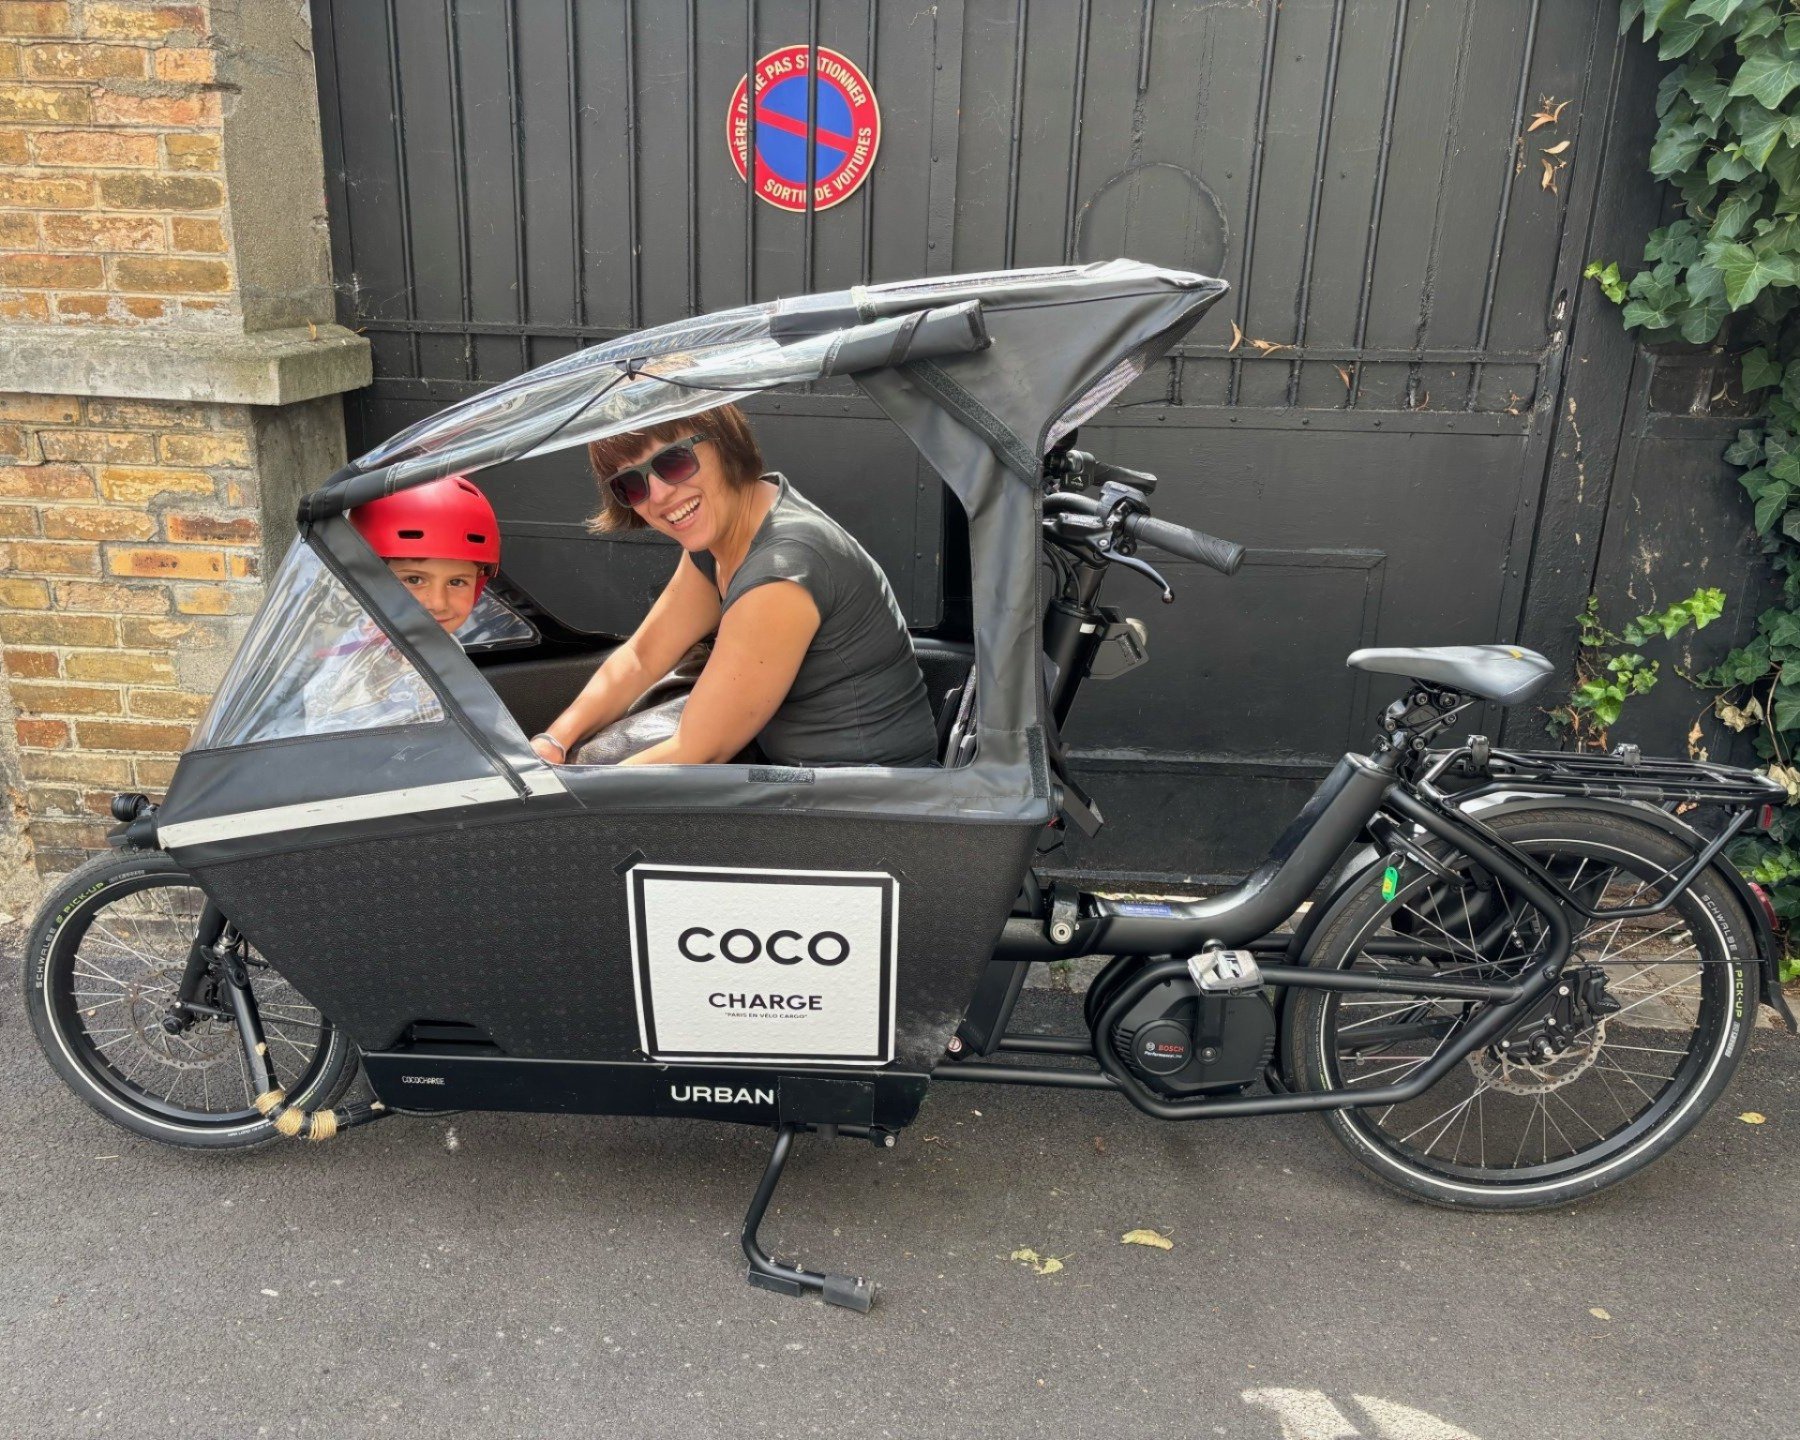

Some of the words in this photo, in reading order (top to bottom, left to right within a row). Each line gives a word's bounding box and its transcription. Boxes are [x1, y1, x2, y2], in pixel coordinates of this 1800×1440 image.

[765, 56, 793, 80] PAS
[764, 179, 807, 203] SORTI
[815, 184, 834, 201] DE
[831, 126, 872, 191] VOITURES
[63, 882, 104, 914] PICK-UP
[1702, 894, 1738, 952] SCHWALBE
[35, 927, 57, 989] SCHWALBE
[678, 926, 851, 967] COCO
[708, 992, 823, 1011] CHARGE
[1735, 969, 1744, 1018] PICK-UP
[1158, 1044, 1184, 1053] BOSCH
[671, 1085, 774, 1105] URBAN
